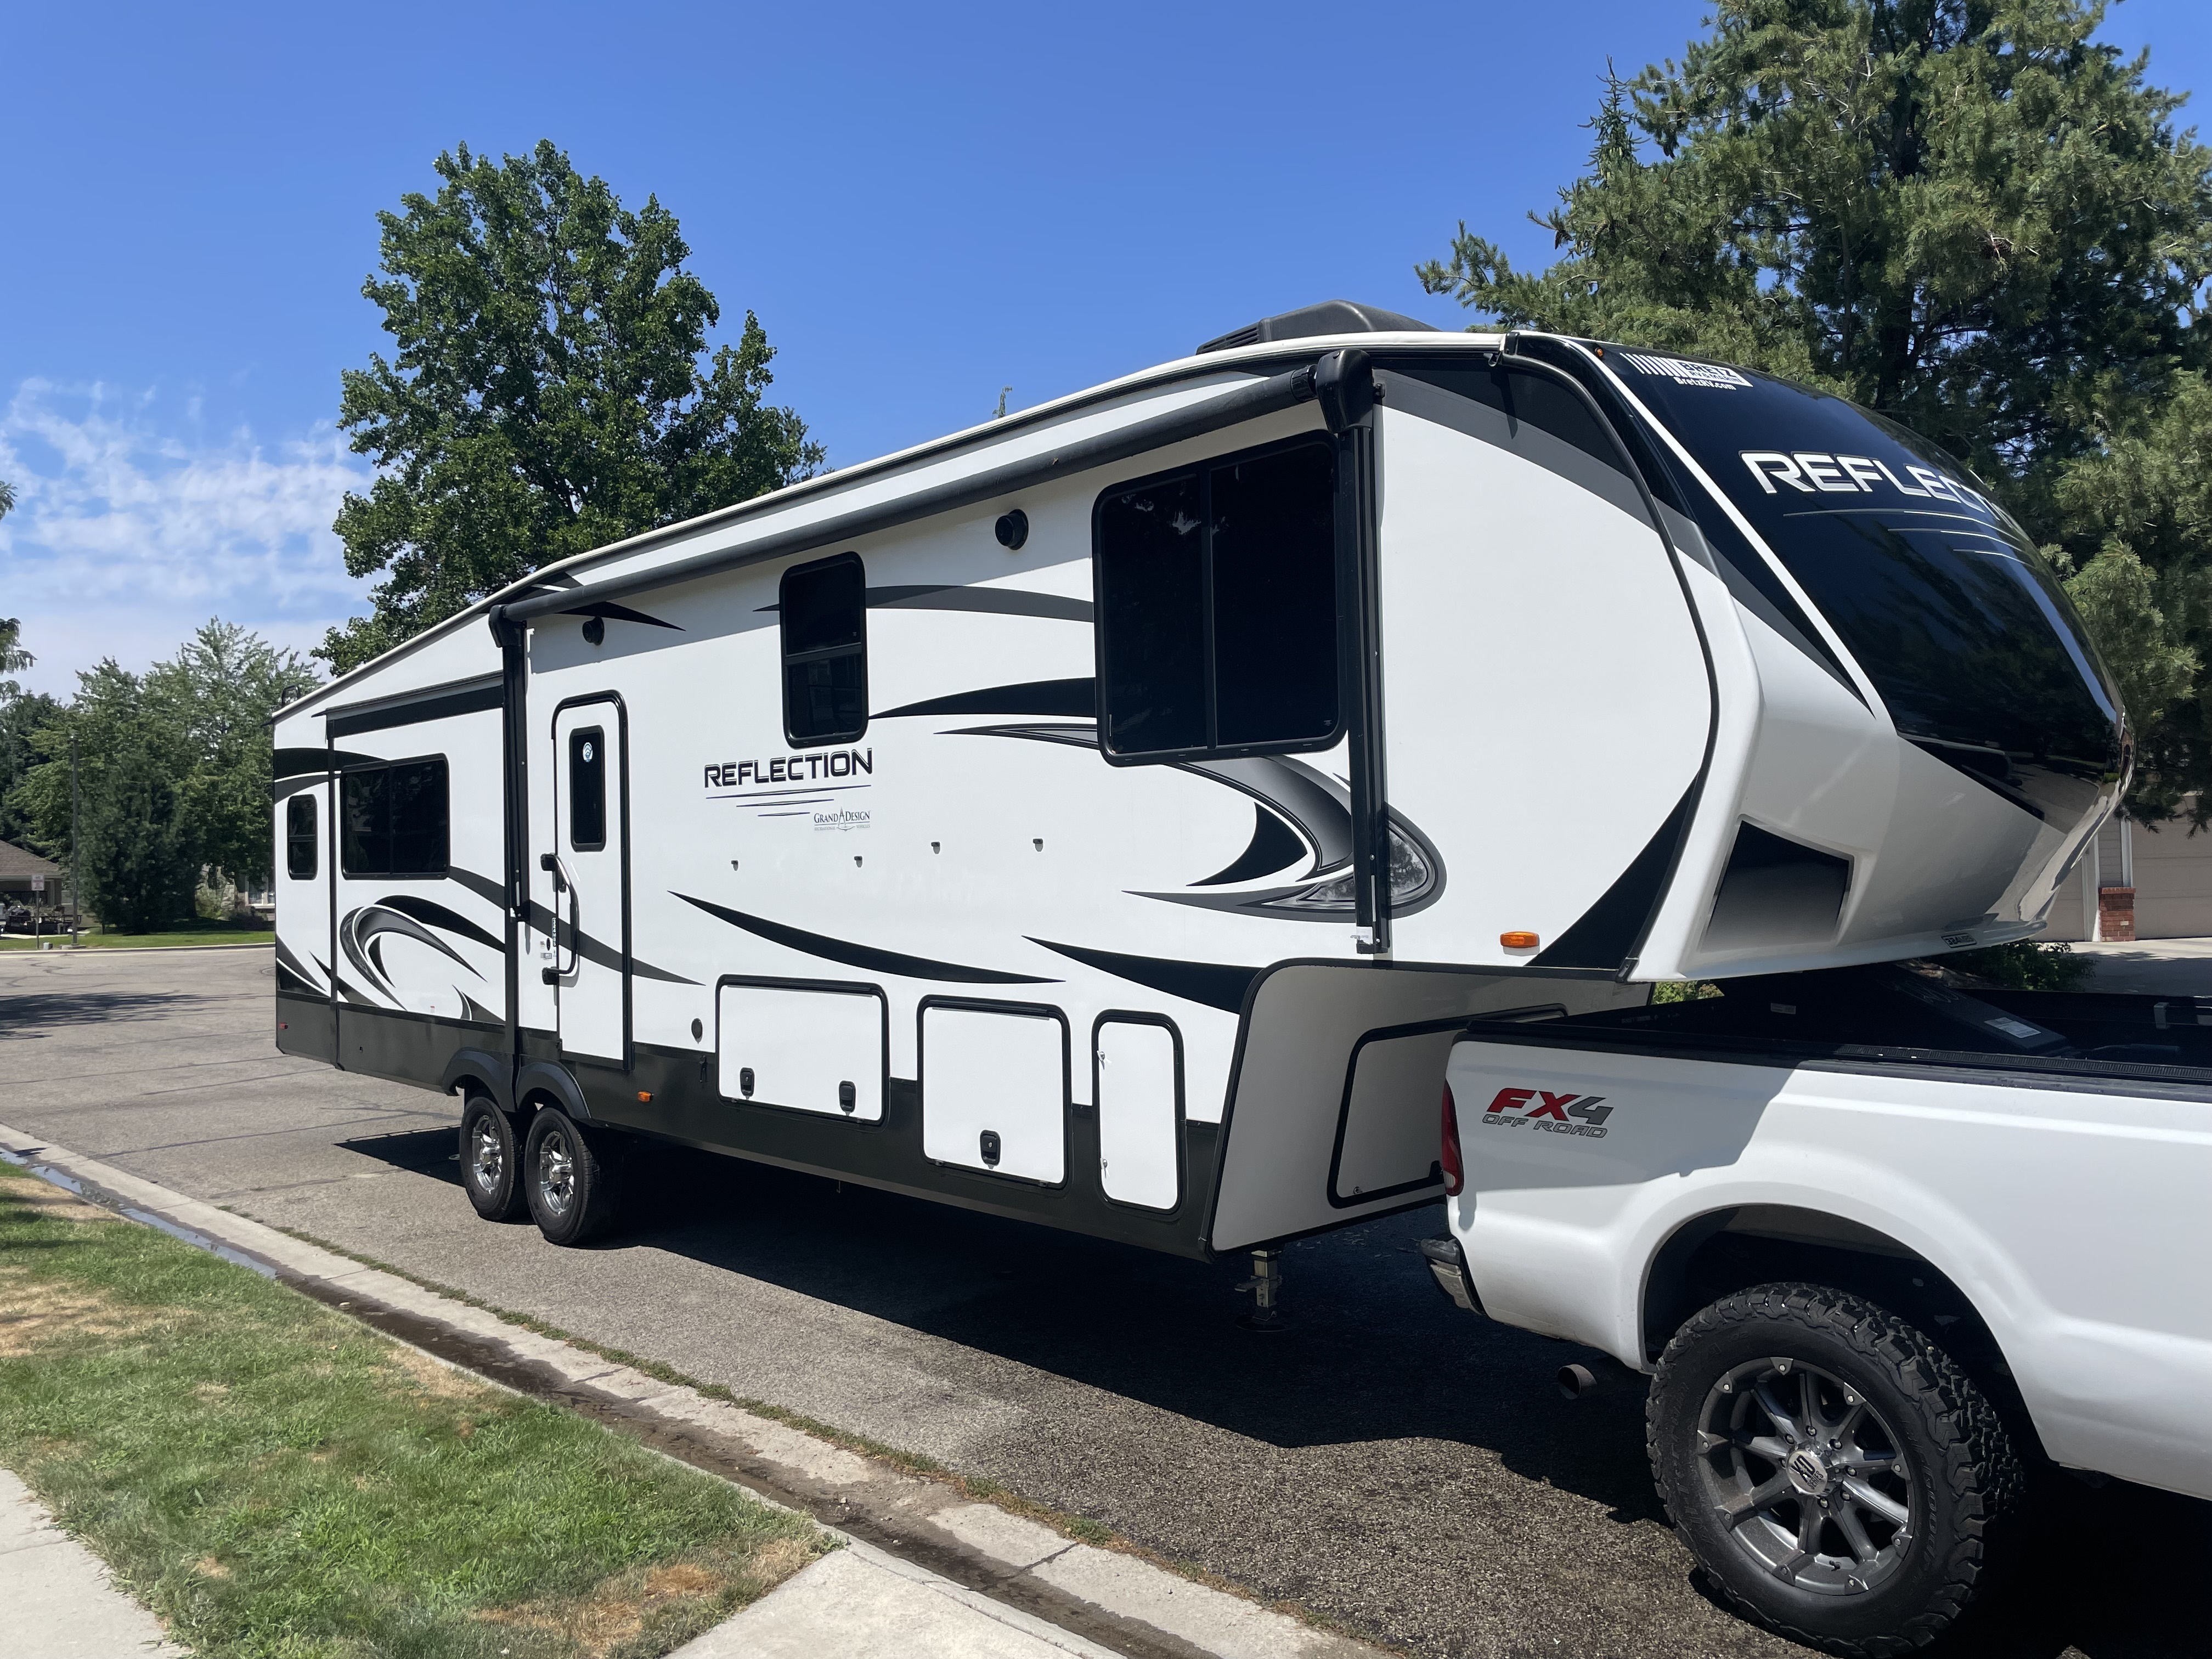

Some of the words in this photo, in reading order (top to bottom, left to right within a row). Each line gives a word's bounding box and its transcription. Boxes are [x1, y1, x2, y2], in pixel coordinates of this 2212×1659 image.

[1677, 362, 1737, 378] BRETZ
[1673, 376, 1737, 390] BretzRV.com
[704, 747, 873, 788] REFLECTION
[1486, 1088, 1614, 1125] FX4
[1482, 1114, 1529, 1127] OFF
[1533, 1120, 1608, 1138] ROAD
[1791, 1455, 1815, 1483] XD
[1807, 1470, 1824, 1489] SERIES
